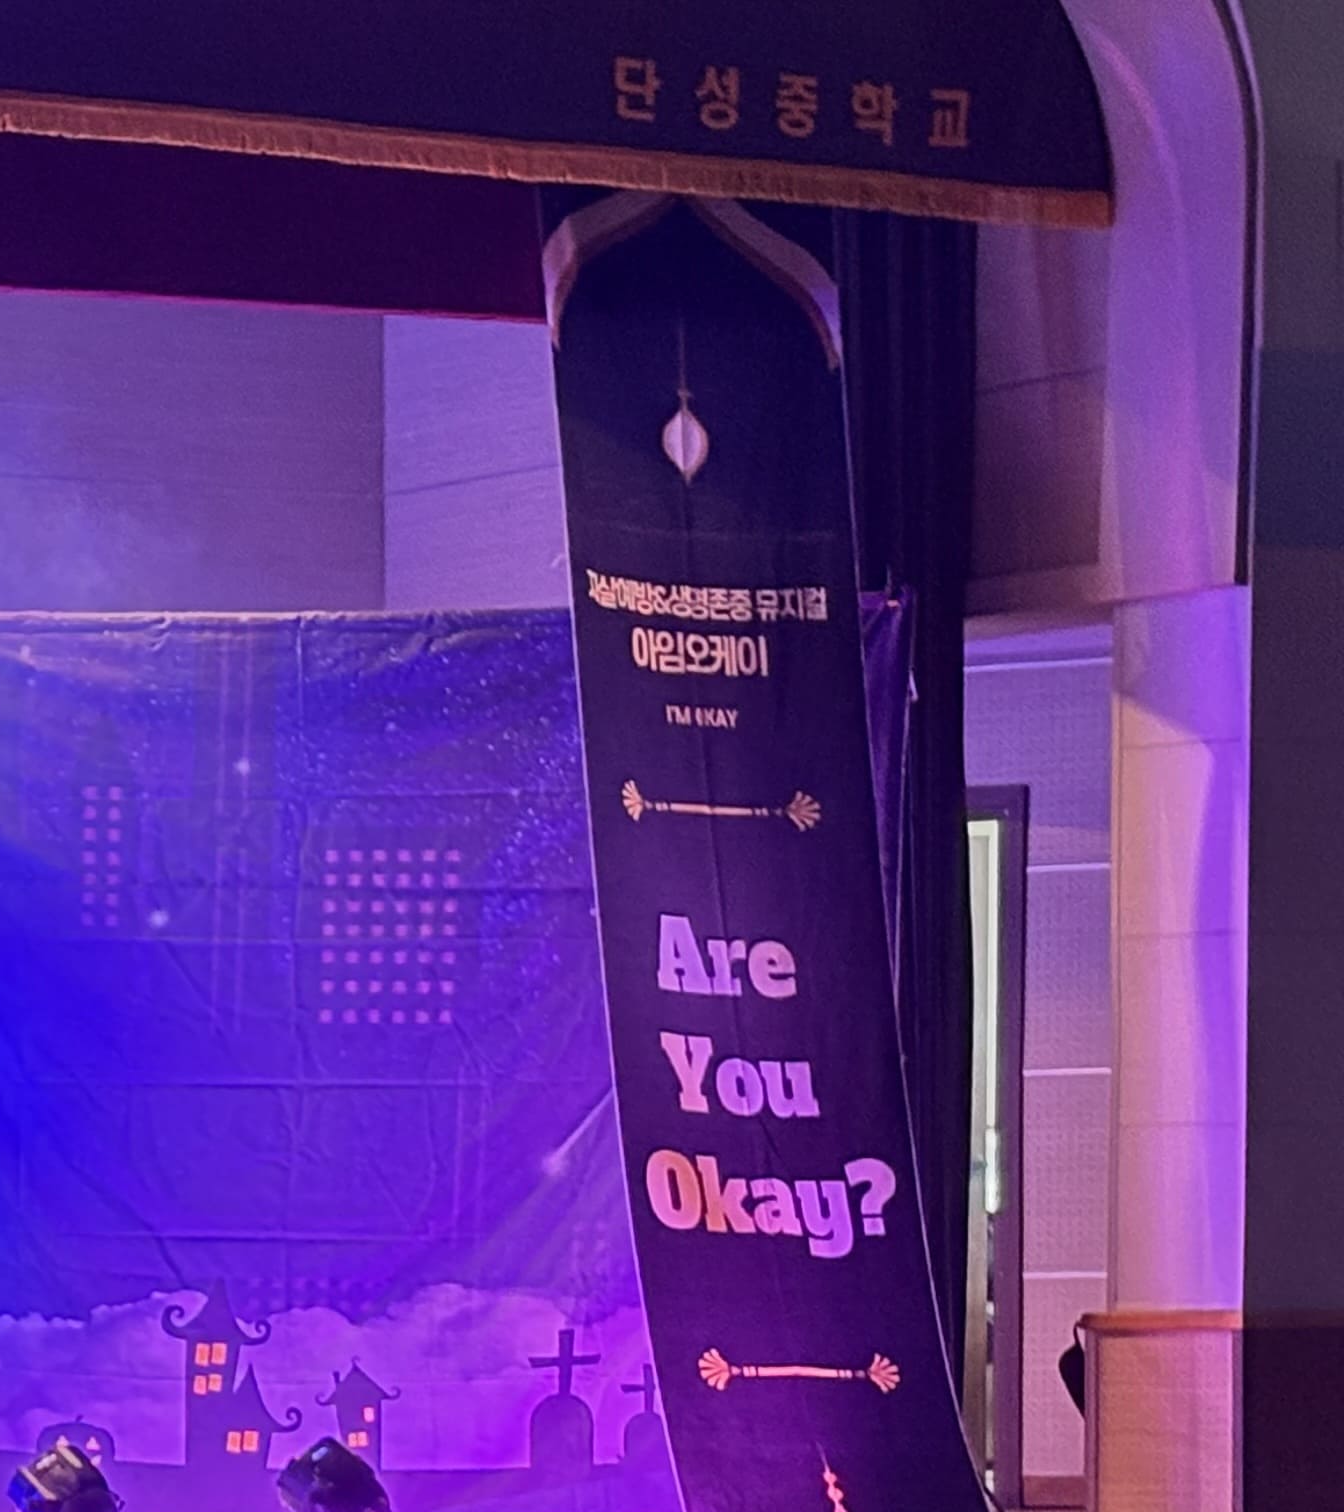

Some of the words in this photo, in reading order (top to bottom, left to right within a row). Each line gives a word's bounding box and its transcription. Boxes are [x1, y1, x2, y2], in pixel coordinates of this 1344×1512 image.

[613, 55, 971, 148] 단성중학교
[755, 585, 829, 622] 뮤지컬
[631, 626, 769, 677] 아임오케이
[656, 913, 798, 999] Are
[659, 1031, 821, 1119] You
[645, 1148, 898, 1259] Okay?
